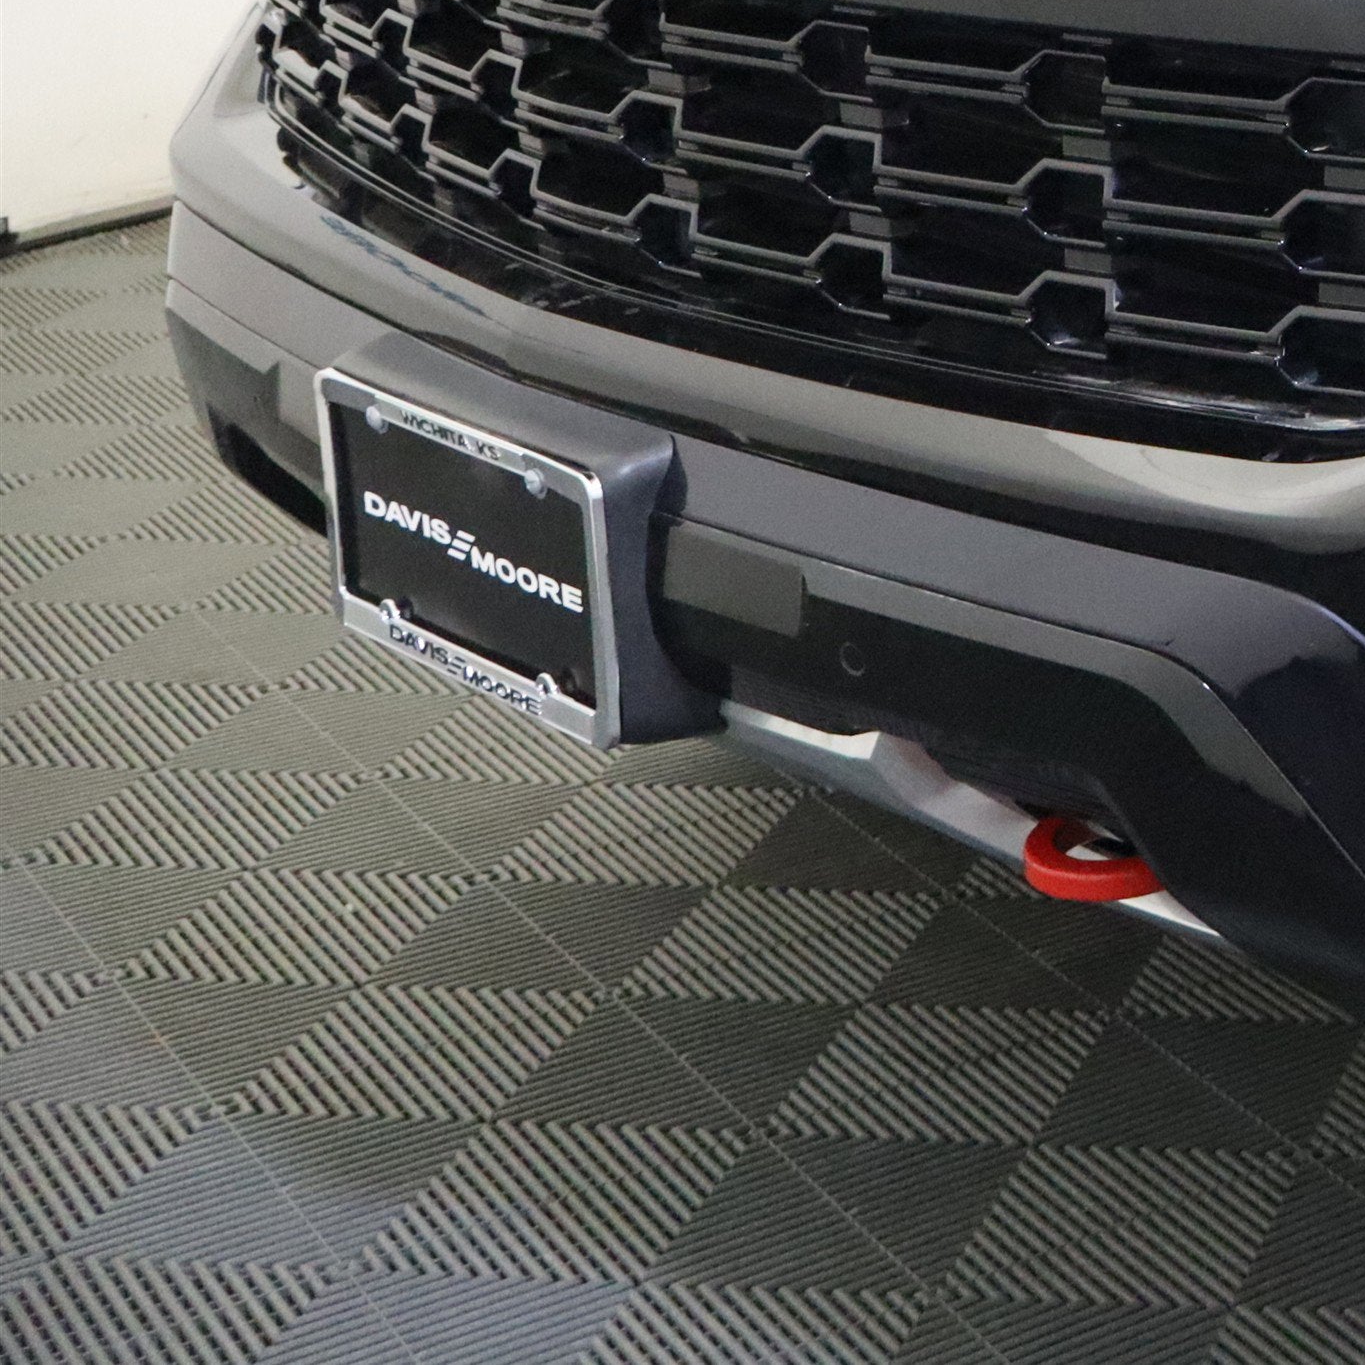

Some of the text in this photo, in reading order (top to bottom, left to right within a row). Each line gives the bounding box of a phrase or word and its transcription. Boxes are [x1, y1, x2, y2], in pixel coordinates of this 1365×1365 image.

[476, 439, 501, 461] KS
[363, 490, 584, 614] DAVIS MOORE
[389, 623, 543, 717] DAVIS MOORE
